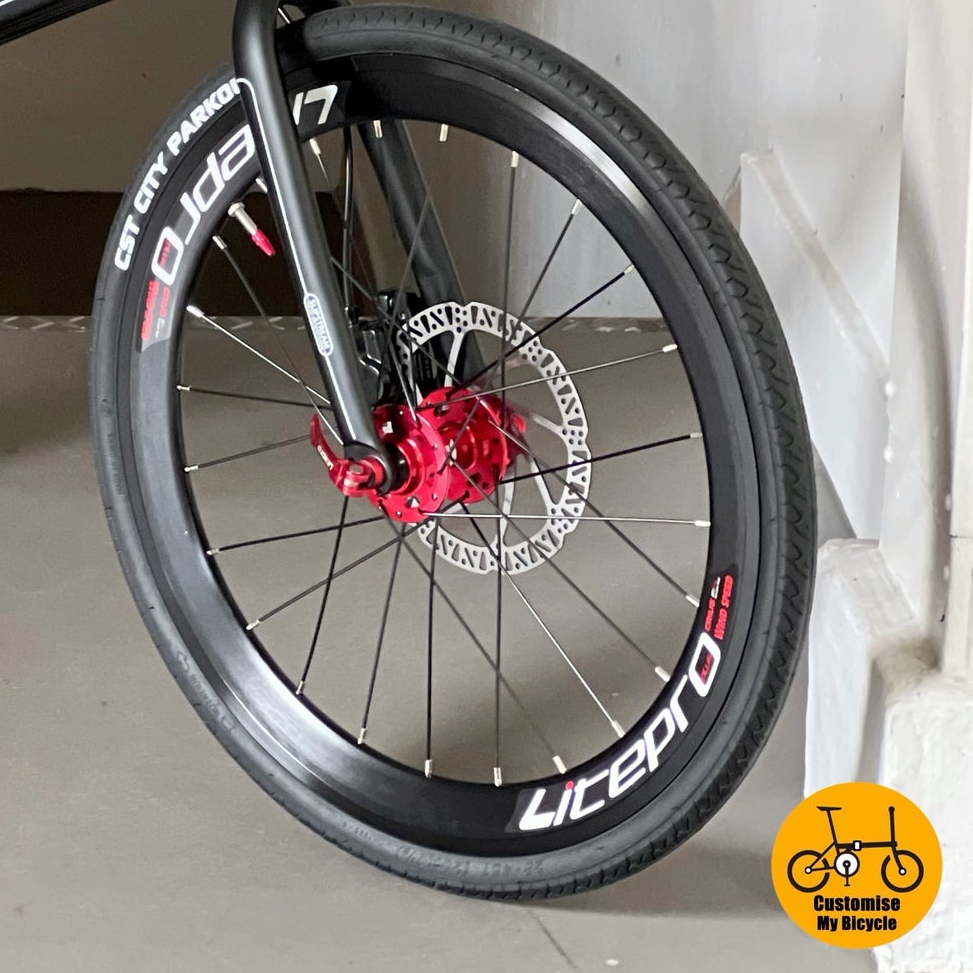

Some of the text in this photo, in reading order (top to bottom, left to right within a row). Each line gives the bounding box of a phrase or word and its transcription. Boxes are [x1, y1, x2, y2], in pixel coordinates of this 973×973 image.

[114, 214, 140, 272] CST
[133, 151, 169, 215] CITY
[518, 631, 721, 831] Litepro
